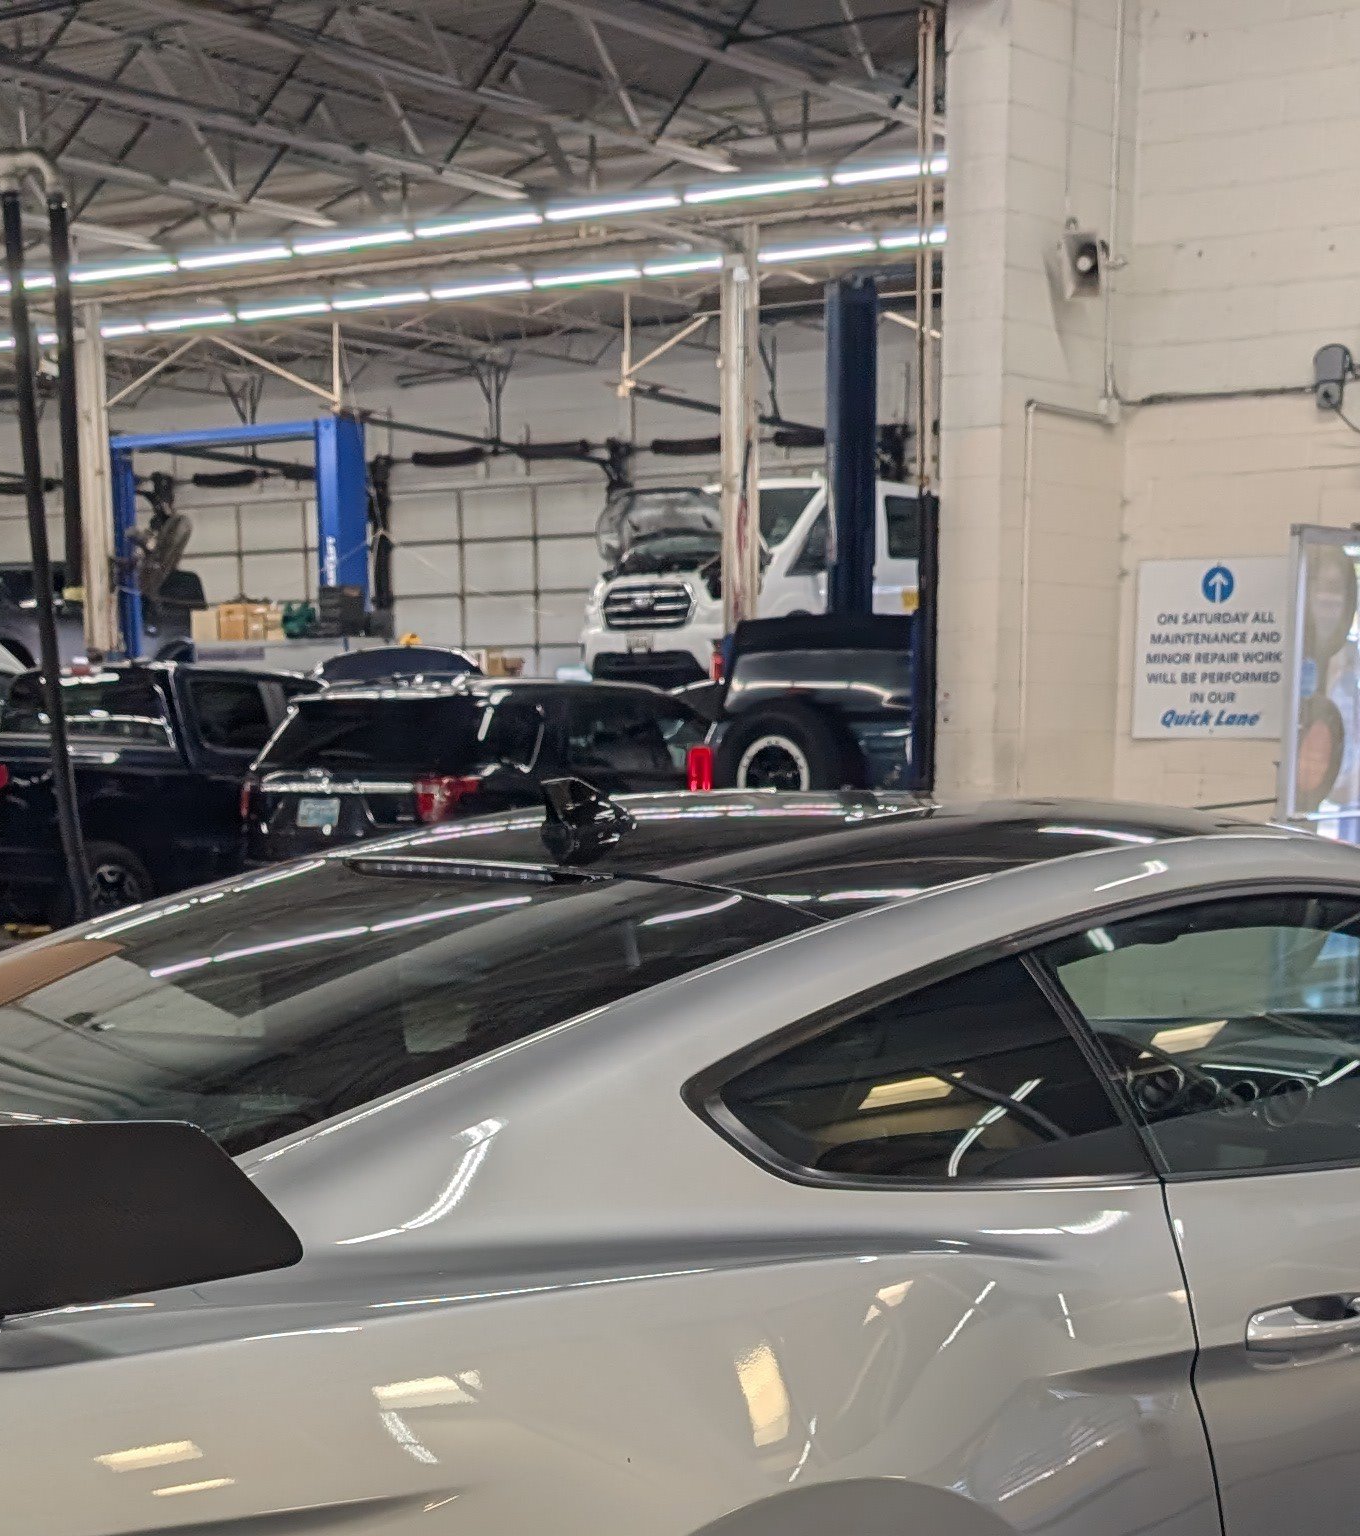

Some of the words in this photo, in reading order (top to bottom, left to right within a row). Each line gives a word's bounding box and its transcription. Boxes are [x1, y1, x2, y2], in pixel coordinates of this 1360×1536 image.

[1157, 613, 1178, 625] ON
[1182, 612, 1249, 625] SATURDAY
[1251, 612, 1275, 624] ALL
[1150, 632, 1247, 645] MAINTENANCE
[1251, 632, 1281, 644] AND
[1146, 653, 1191, 665] MINOR
[1195, 652, 1239, 664] REPAIR
[1243, 651, 1282, 663] WORK
[1147, 672, 1176, 684] WILL
[1181, 672, 1197, 684] BE
[1201, 671, 1280, 684] PERFORMED
[1190, 692, 1204, 704] IN
[1207, 692, 1236, 704] OUR
[1161, 709, 1211, 727] Quick
[1215, 710, 1260, 727] Lane
